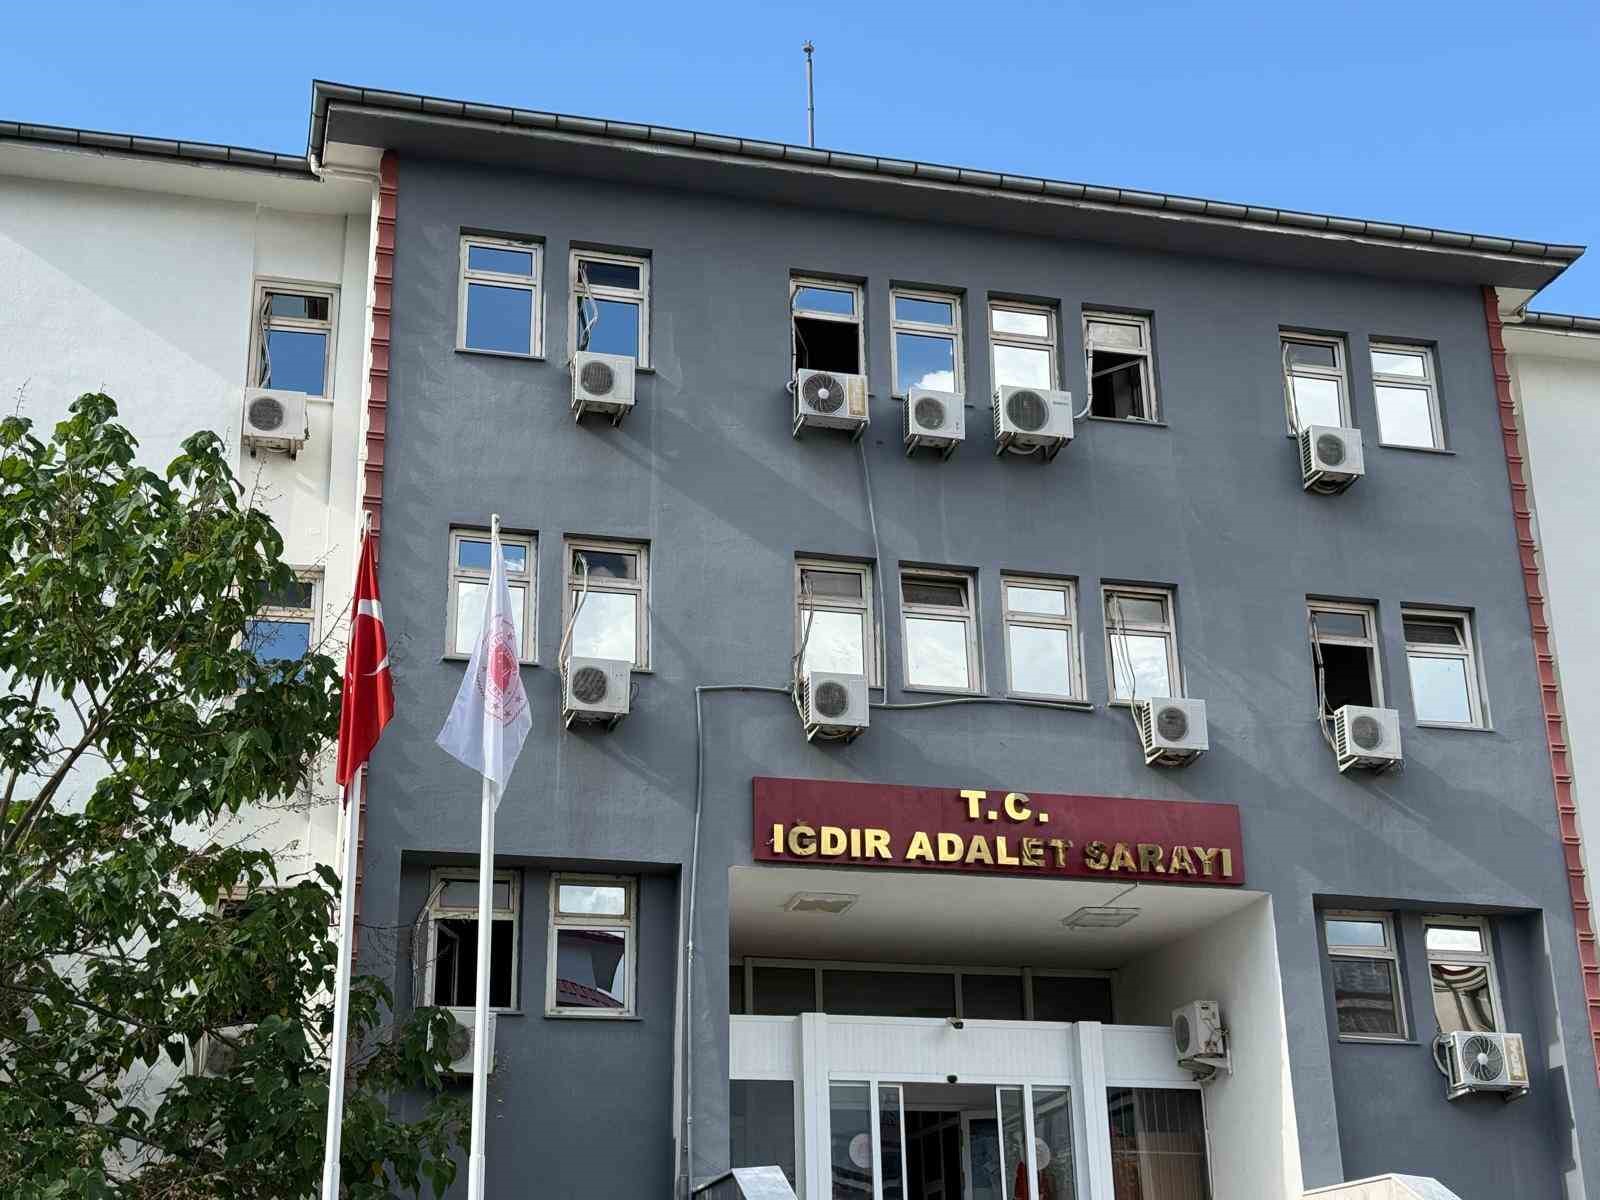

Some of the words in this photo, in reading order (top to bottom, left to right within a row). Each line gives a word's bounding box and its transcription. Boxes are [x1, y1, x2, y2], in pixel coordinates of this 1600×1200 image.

[960, 789, 1049, 823] T.C.
[905, 831, 1074, 868] ADALET
[1085, 840, 1233, 877] SARAYI
